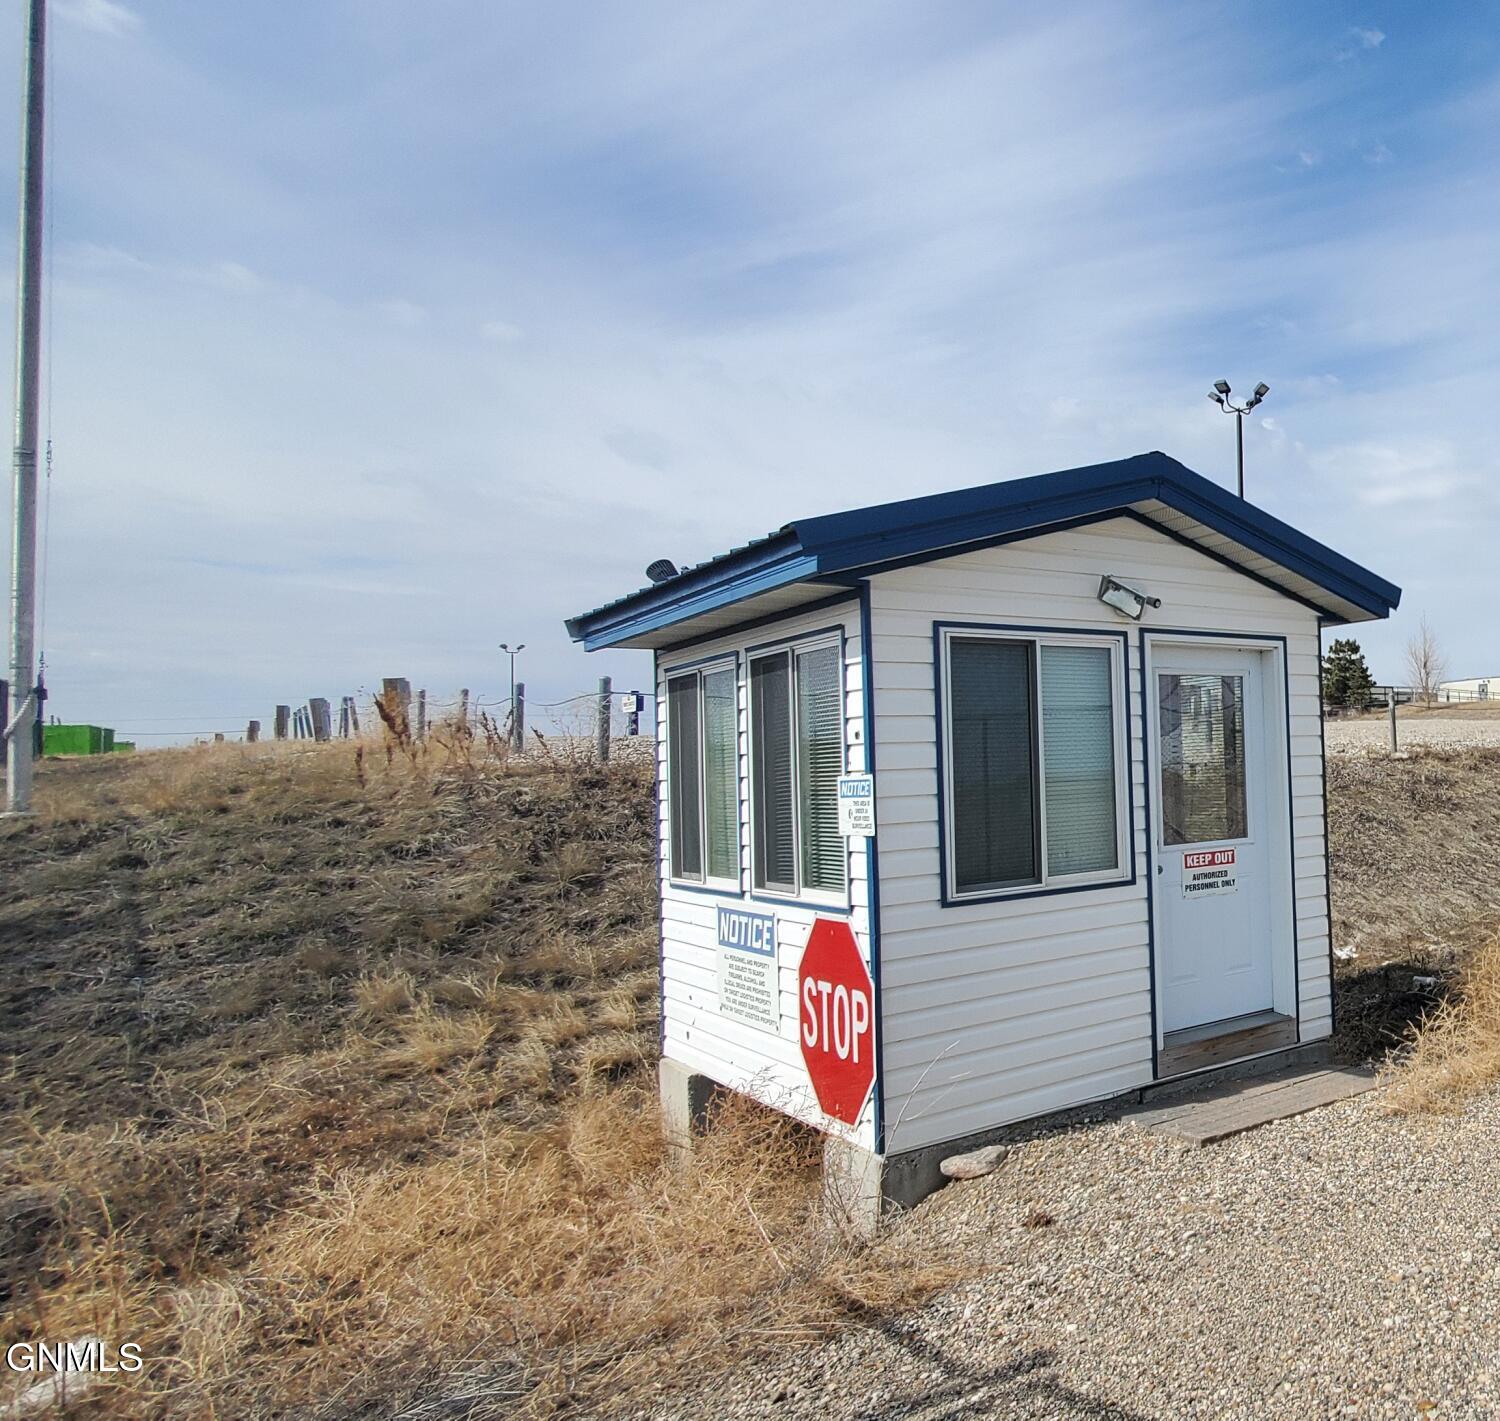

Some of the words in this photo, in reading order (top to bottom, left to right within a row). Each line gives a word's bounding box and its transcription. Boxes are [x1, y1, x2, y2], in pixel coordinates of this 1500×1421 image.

[841, 781, 870, 796] NOTICE
[1186, 854, 1212, 867] KEEP
[1214, 851, 1234, 864] OUT
[1192, 870, 1228, 881] AUTHORIZED
[1184, 881, 1220, 892] PERSONNEL
[1221, 879, 1236, 888] ONLY
[720, 911, 773, 951] NOTICE
[803, 976, 869, 1064] STOP
